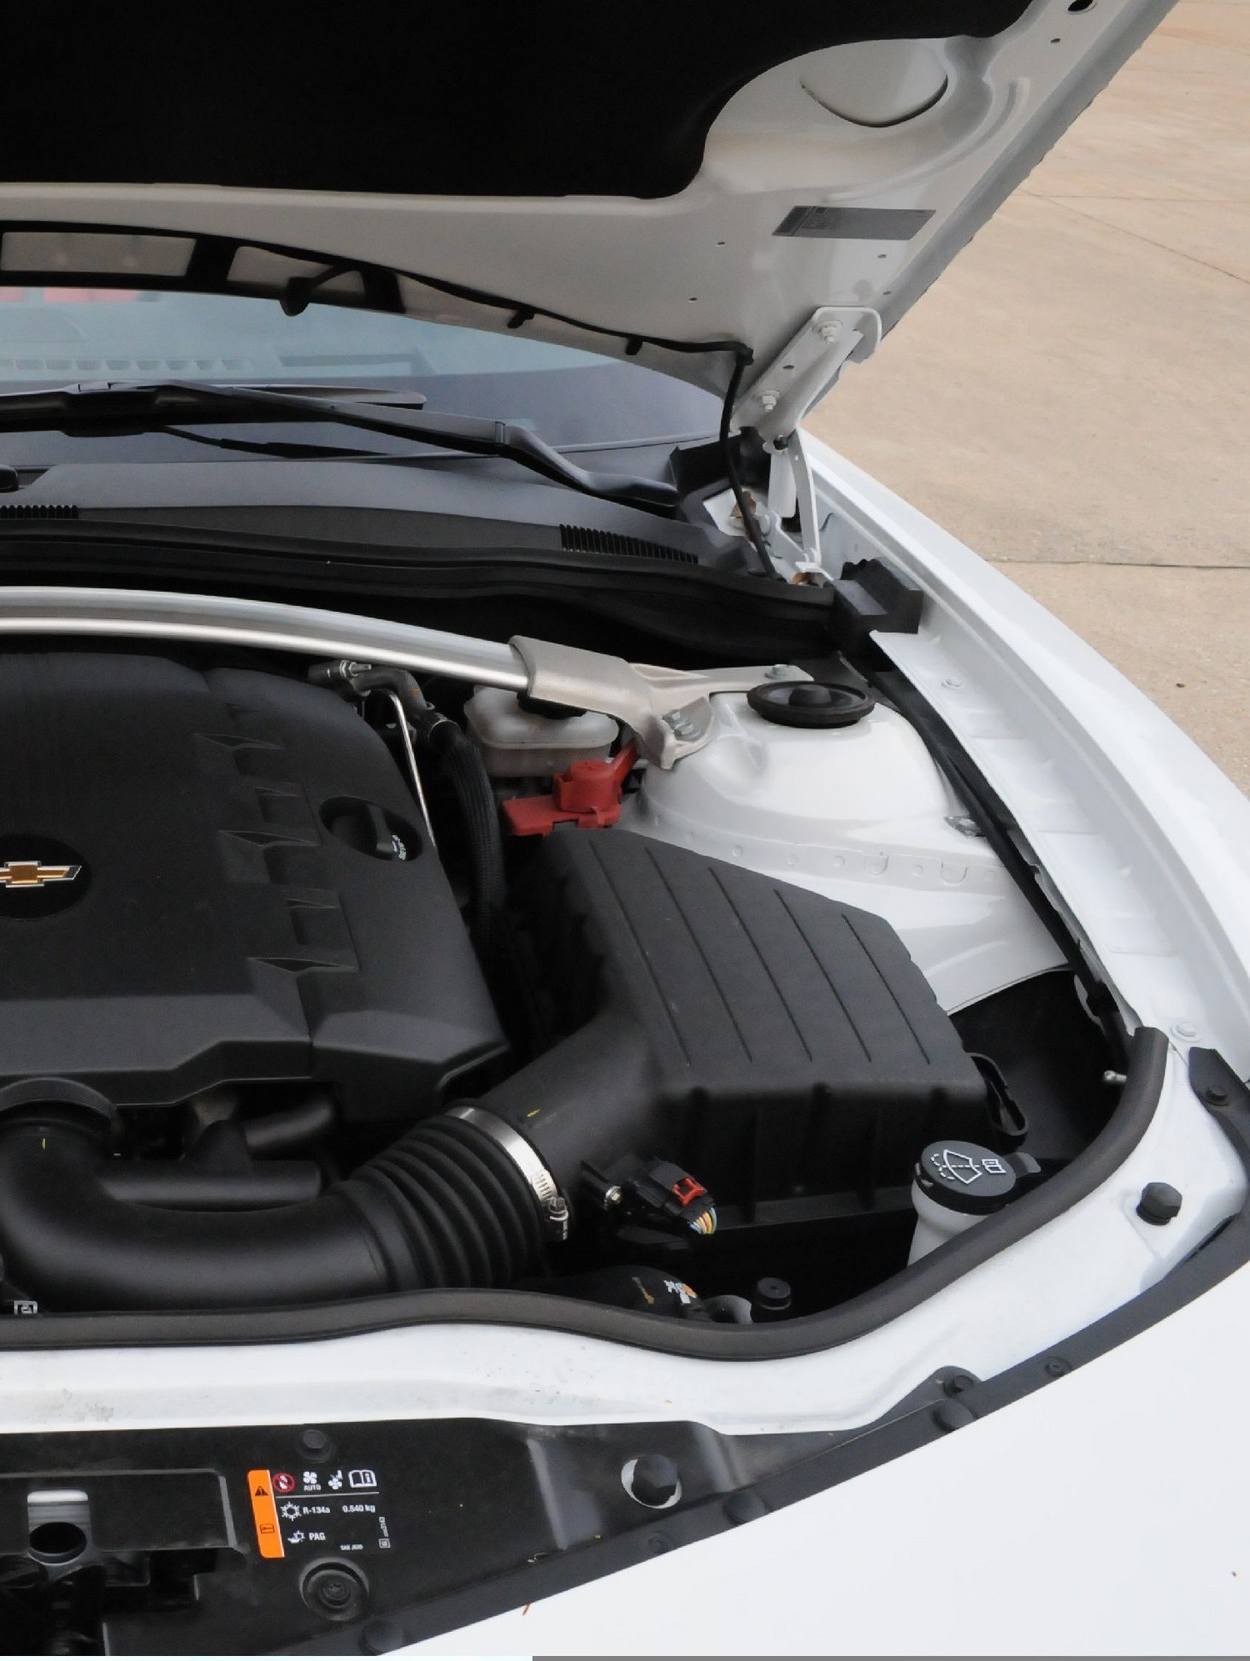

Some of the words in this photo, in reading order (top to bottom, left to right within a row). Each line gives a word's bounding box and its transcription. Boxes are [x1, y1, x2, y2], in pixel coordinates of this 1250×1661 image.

[302, 1507, 330, 1515] R-134a
[343, 1505, 364, 1513] 0.540
[365, 1504, 375, 1513] kg
[309, 1532, 326, 1541] PAG
